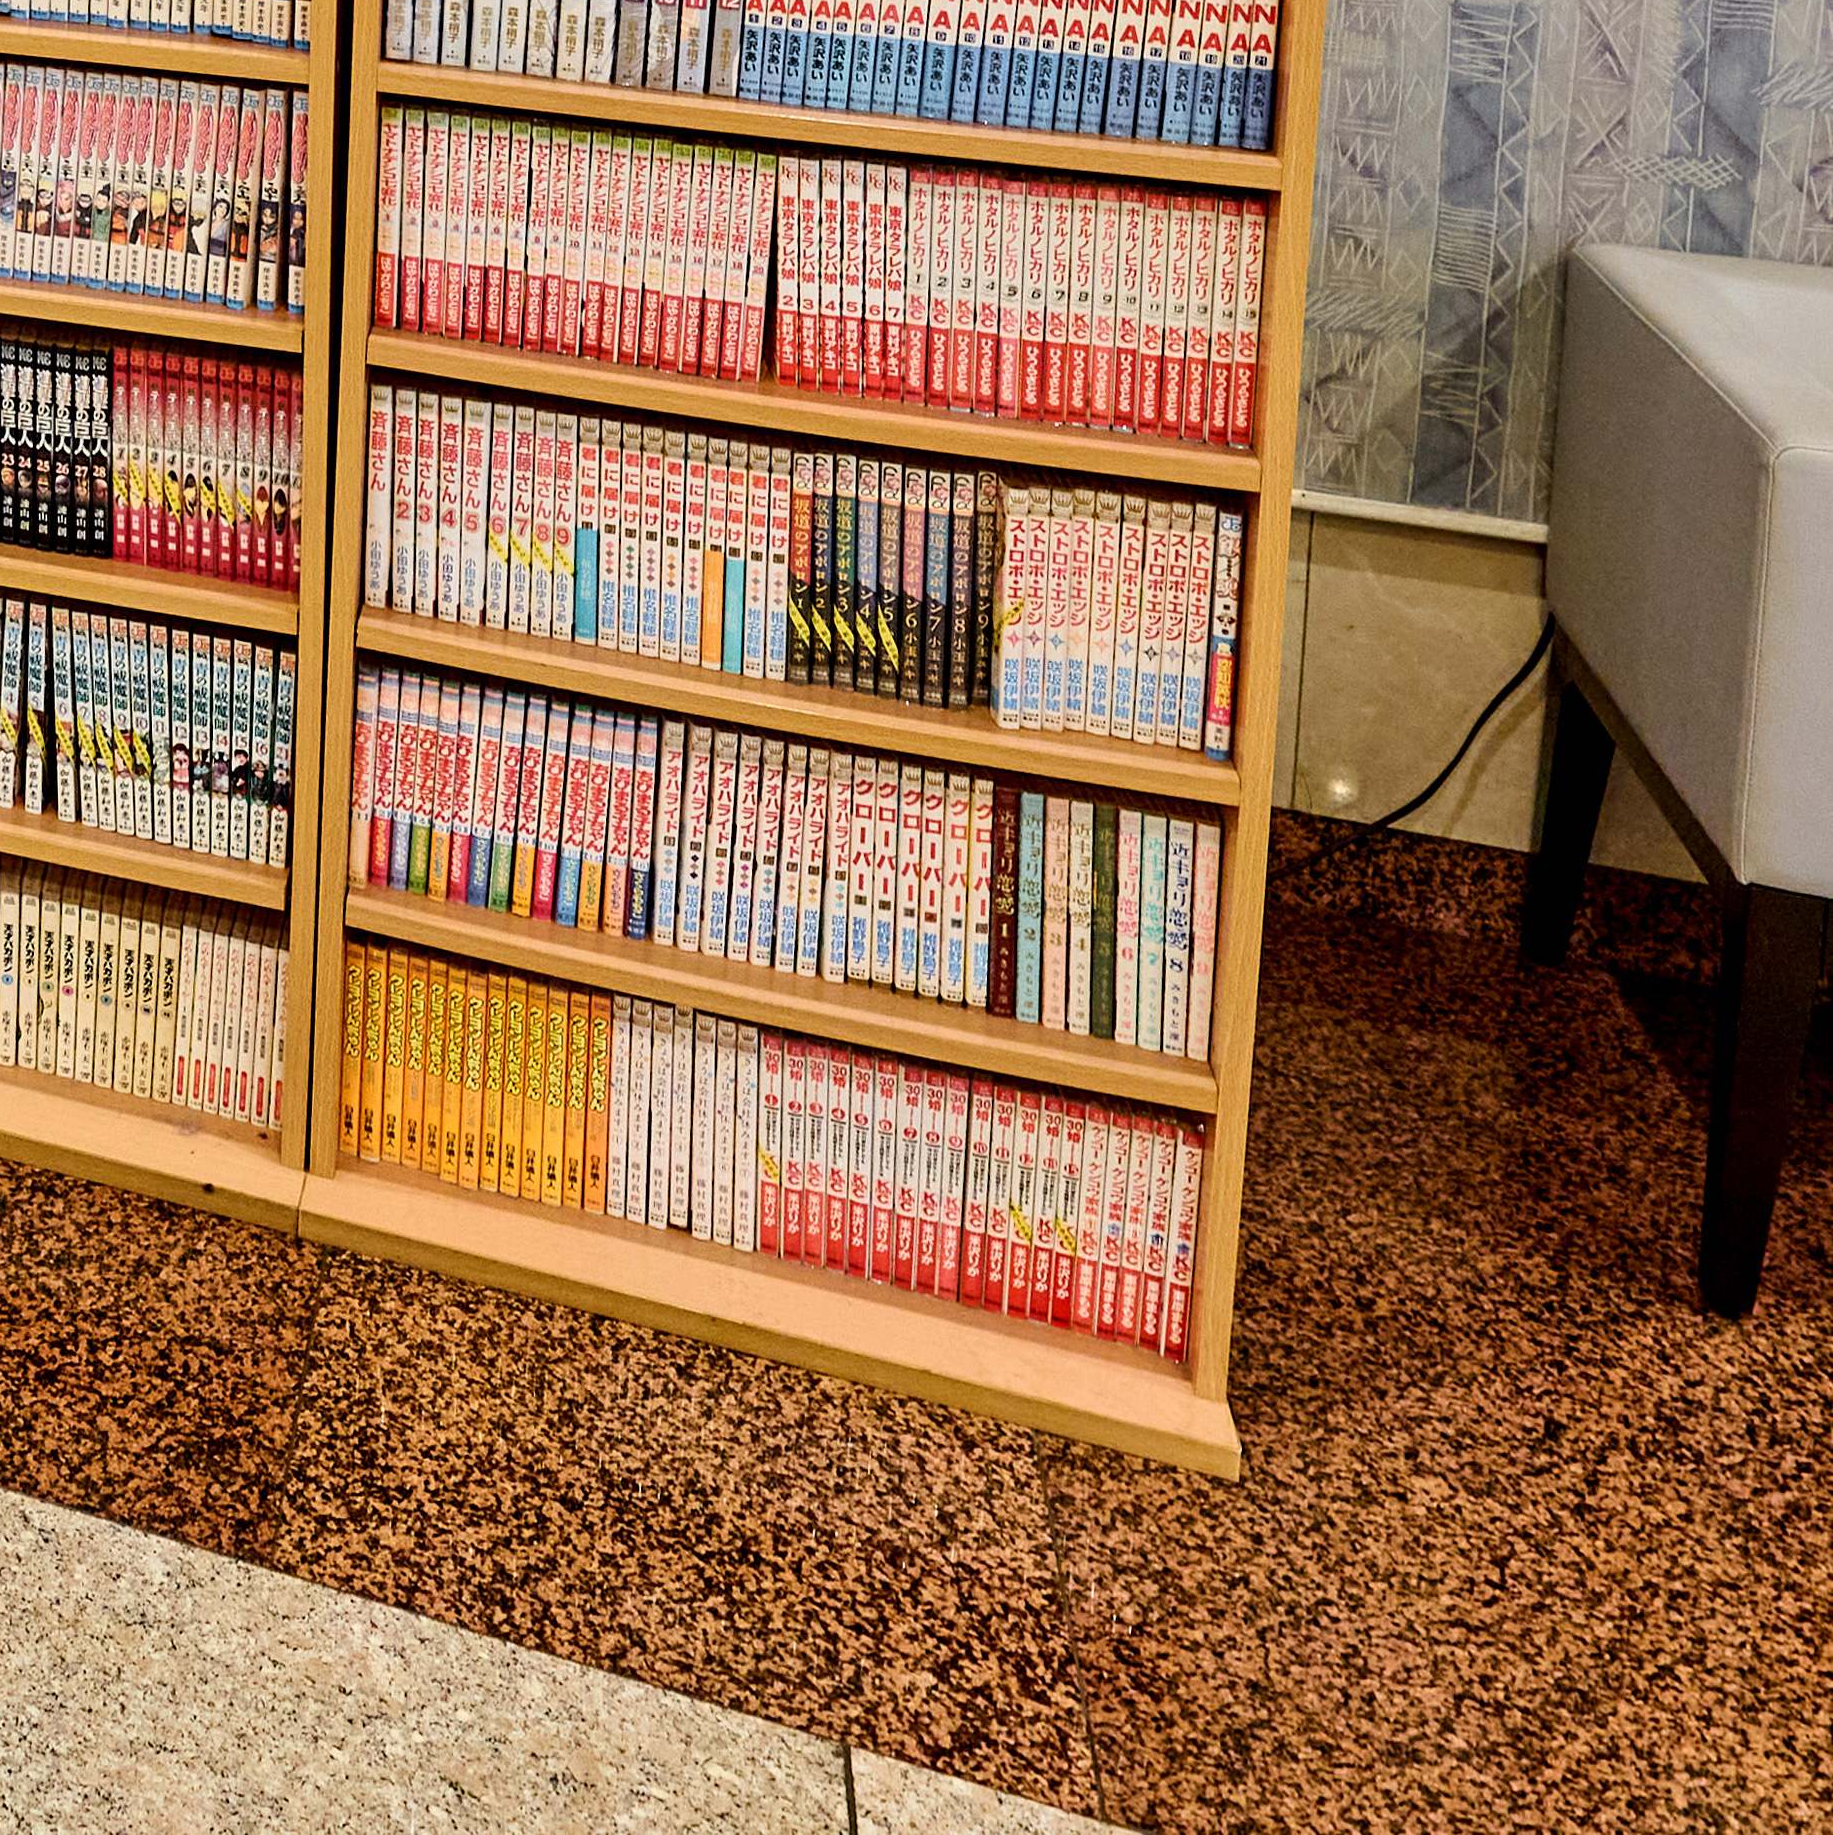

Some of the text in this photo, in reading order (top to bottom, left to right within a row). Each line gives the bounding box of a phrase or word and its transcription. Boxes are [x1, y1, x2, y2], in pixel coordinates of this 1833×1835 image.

[782, 195, 796, 306] 東京タラレバ娘 2
[823, 197, 838, 311] 東京タラレバ娘 4
[845, 199, 860, 312] 東京タラレバ娘 5
[887, 205, 903, 292] 東京タラレバ娘
[936, 190, 951, 273] ホタルノヒカリ
[959, 190, 975, 274] ホタルノヒカリ
[888, 307, 901, 318] 7
[960, 278, 972, 289] 3
[92, 466, 107, 478] 28
[396, 413, 414, 497] 斉藤さん
[441, 421, 459, 505] 斉藤さん
[514, 430, 534, 514] 斉藤さん
[603, 448, 619, 519] 君に届け
[442, 507, 455, 527] 4
[1119, 527, 1141, 635] ストロボ・エッジ
[1144, 531, 1168, 641] ストロボ・エッジ
[954, 619, 966, 633] 8
[739, 764, 758, 847] アオハライド
[852, 779, 875, 891] クローバー
